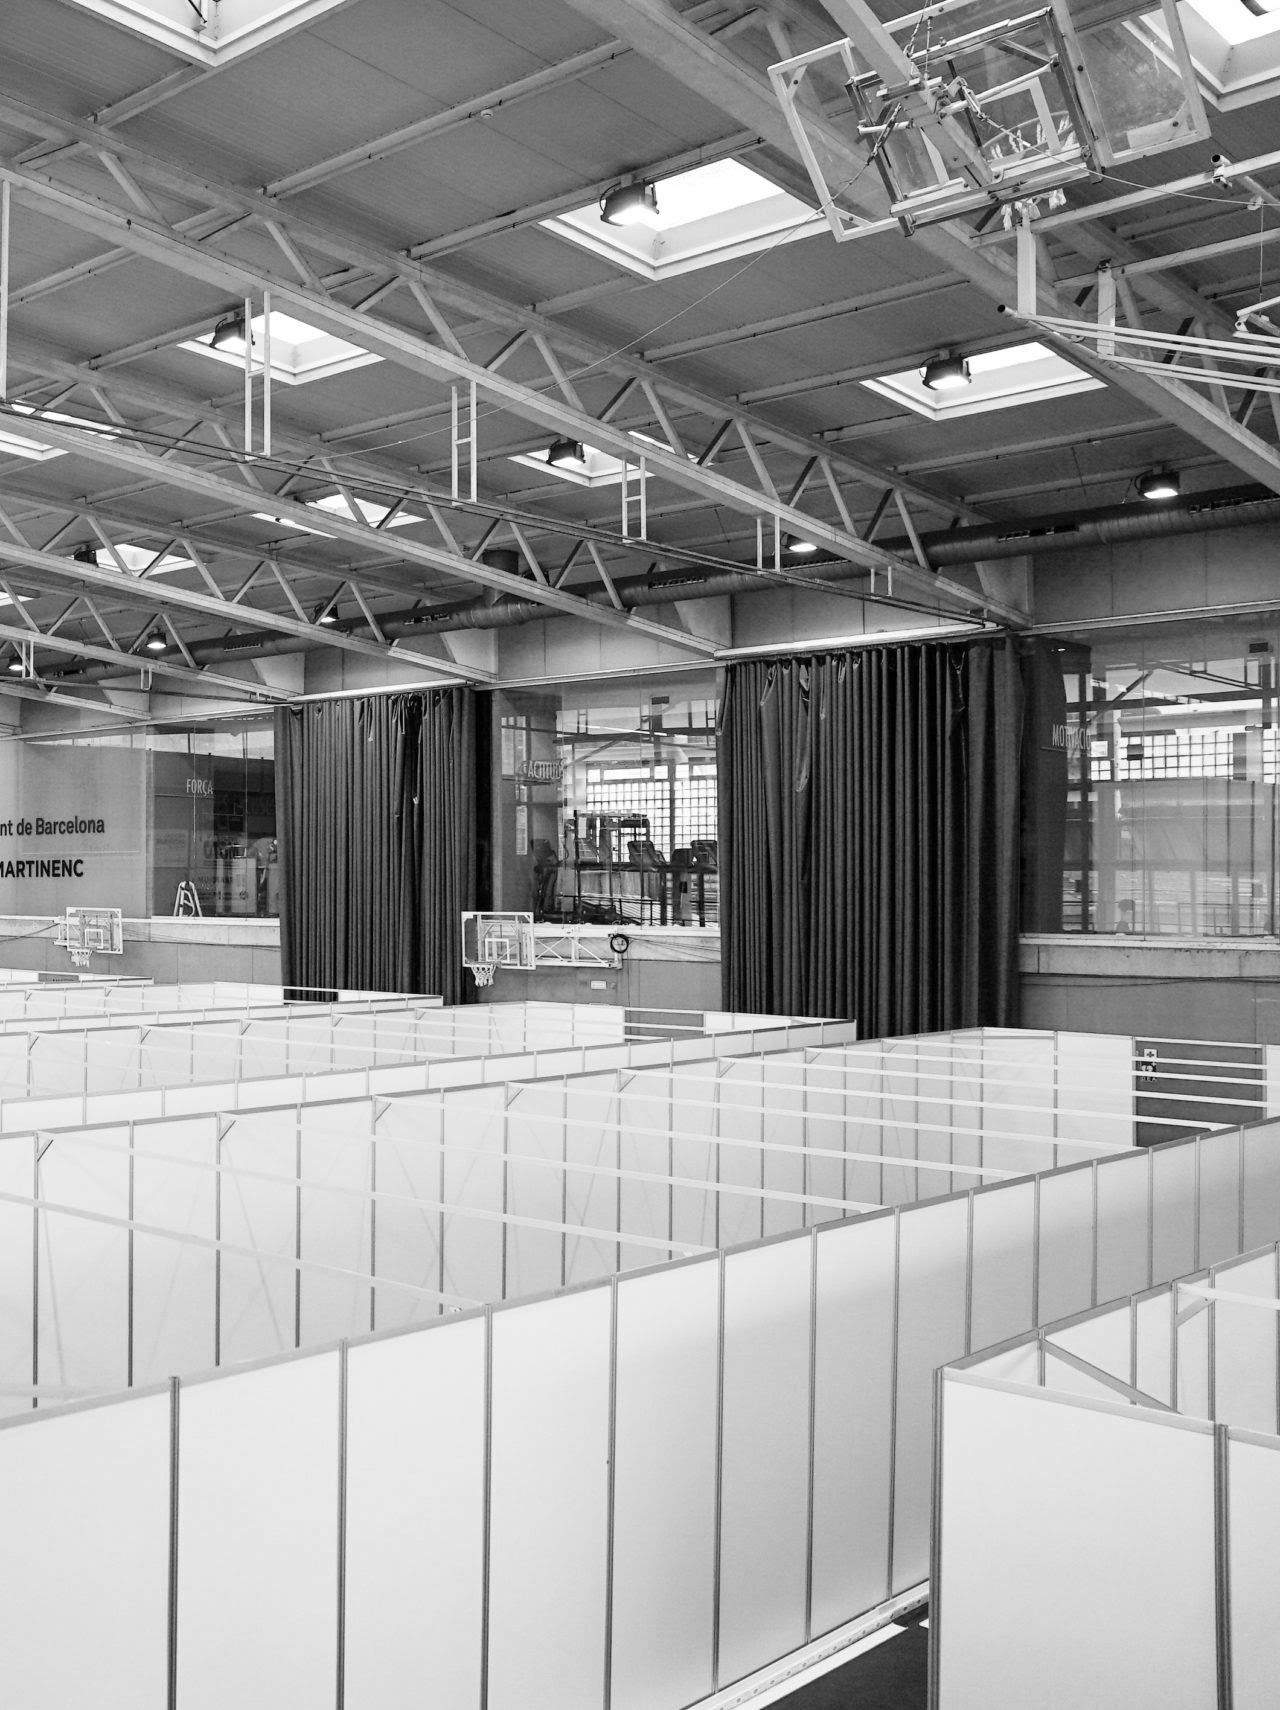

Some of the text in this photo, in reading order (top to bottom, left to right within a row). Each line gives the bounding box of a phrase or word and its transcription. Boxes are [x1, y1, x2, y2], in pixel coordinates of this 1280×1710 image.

[186, 778, 214, 797] FORÇA
[16, 818, 32, 836] de
[35, 816, 105, 836] Barcelona
